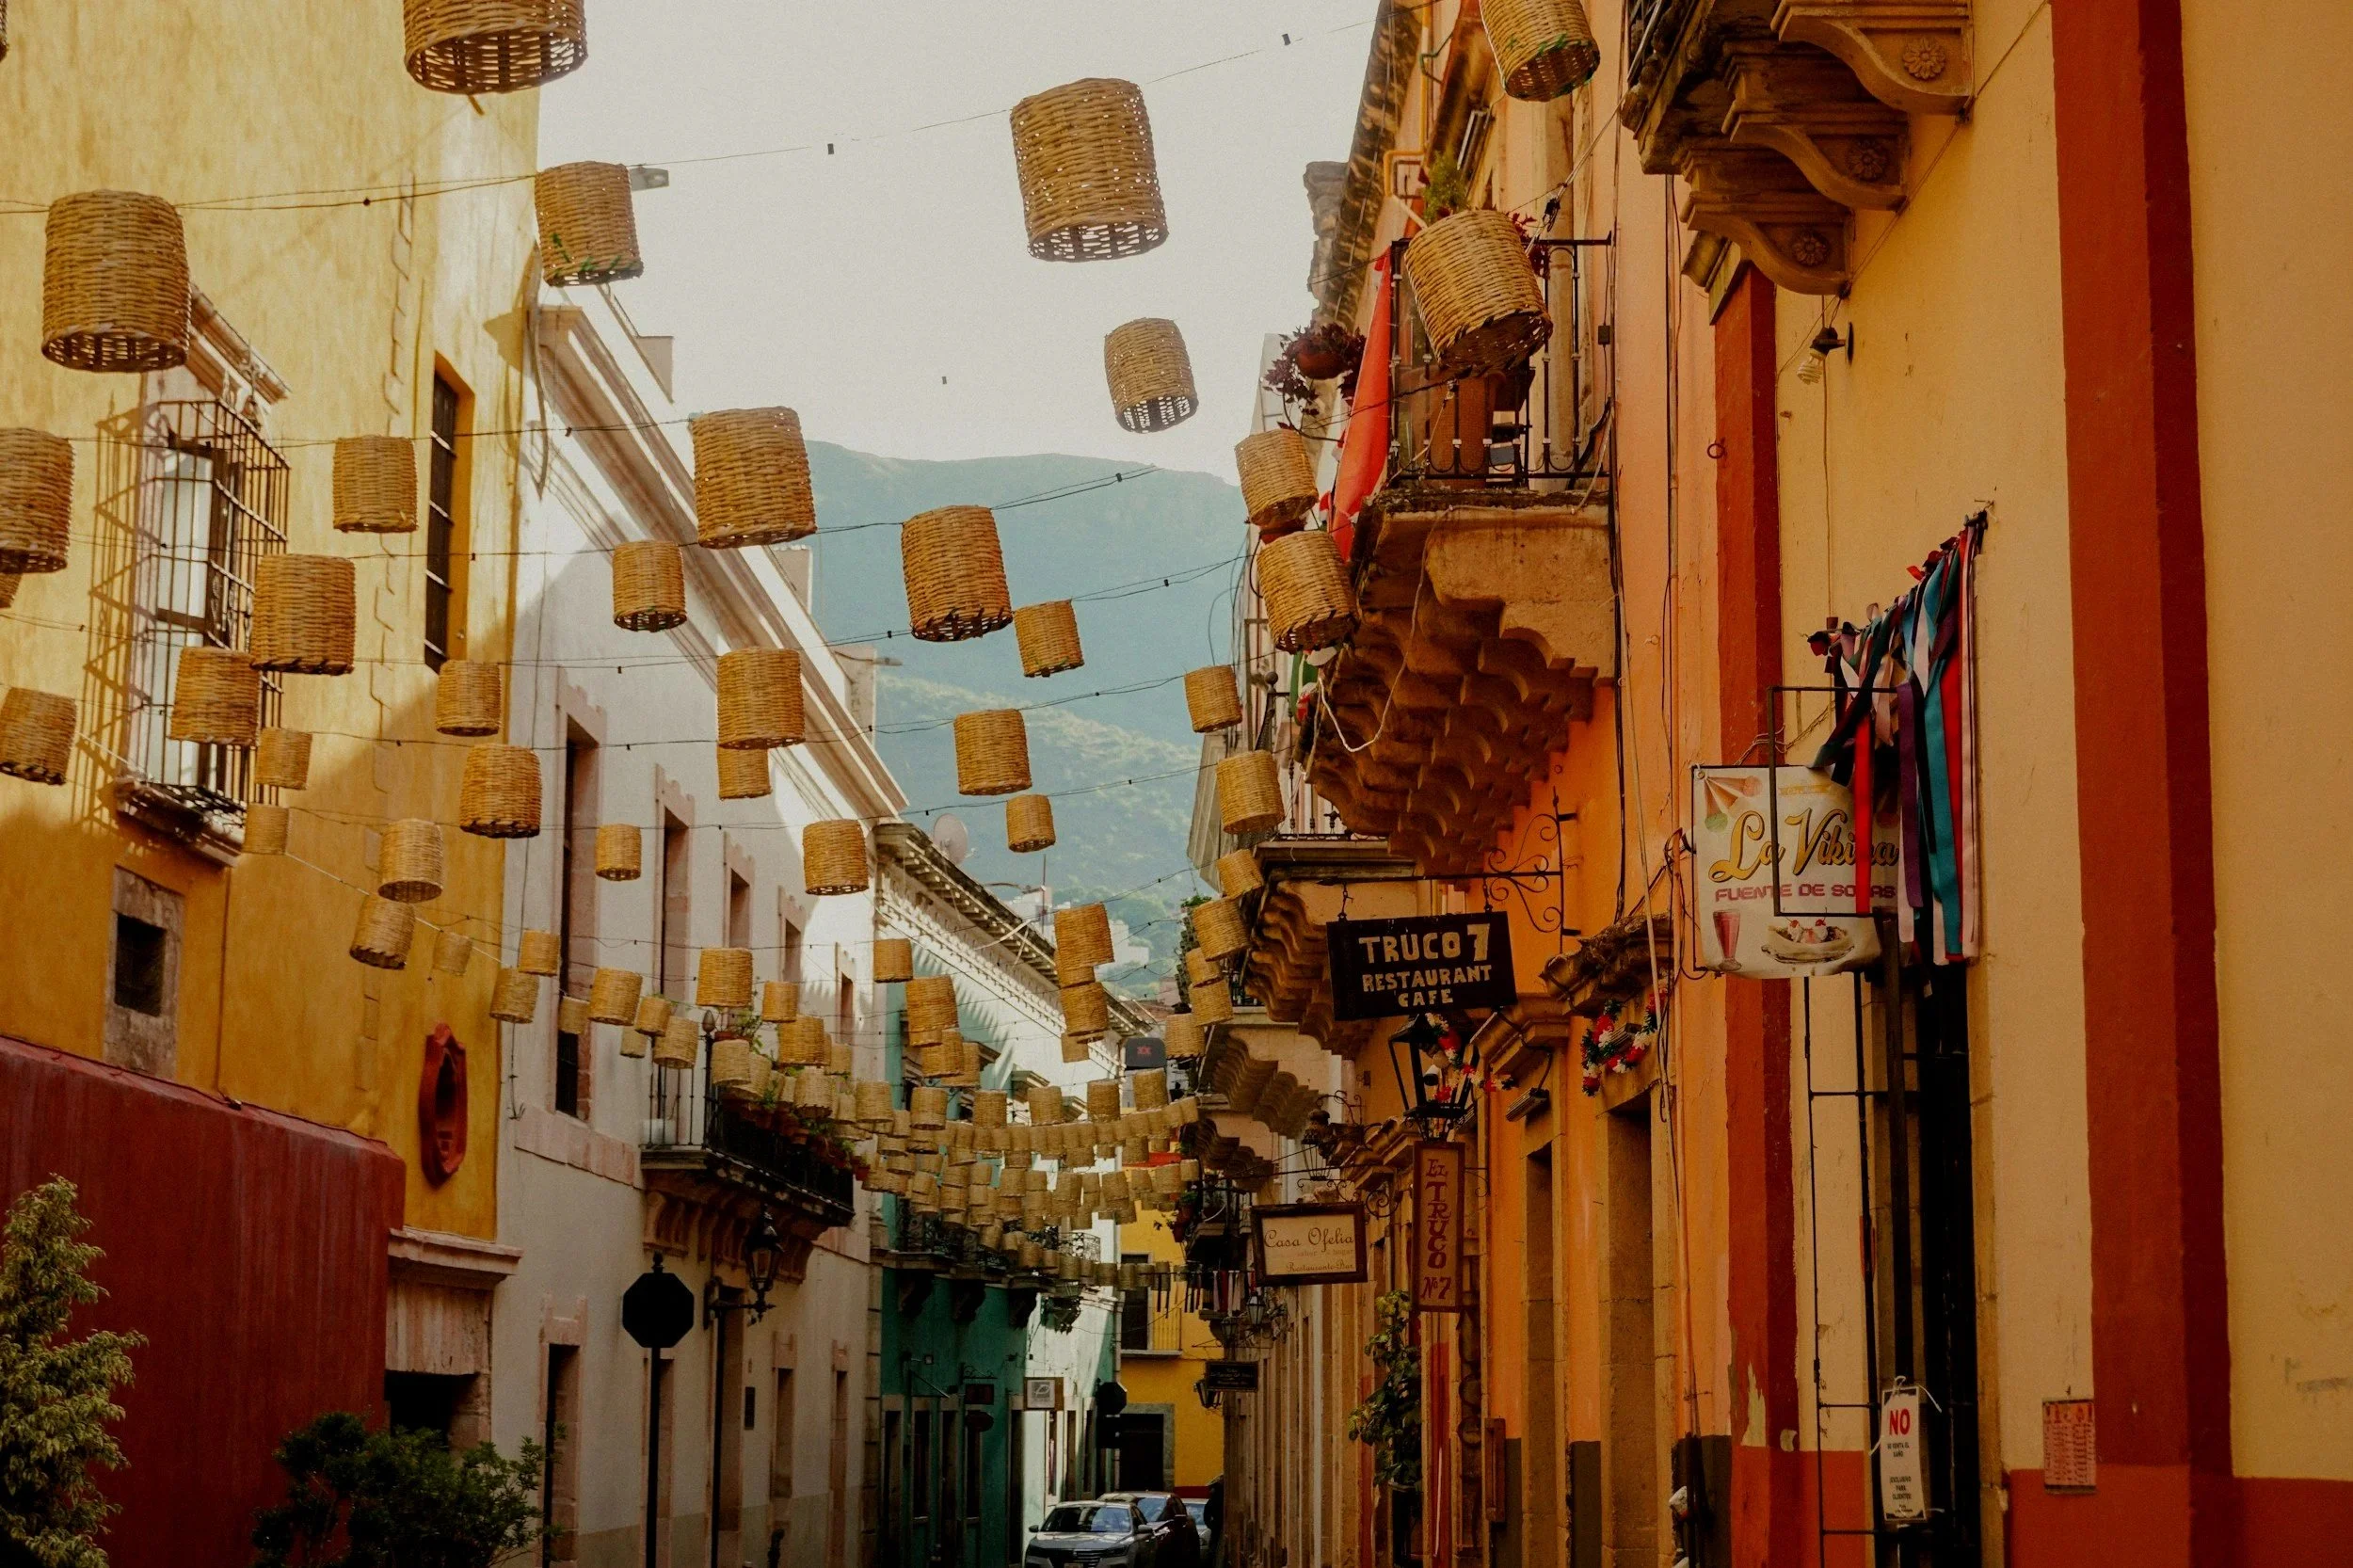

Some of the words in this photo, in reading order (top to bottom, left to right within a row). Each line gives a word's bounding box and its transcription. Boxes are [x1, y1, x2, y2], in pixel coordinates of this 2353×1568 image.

[1708, 809, 1785, 882] La
[1785, 807, 1899, 876] Vikia
[1715, 883, 1793, 903] FUENTE
[1799, 884, 1825, 897] DE
[1832, 884, 1897, 899] SOAS
[1359, 932, 1461, 964] TRUCO
[1466, 923, 1491, 962] 7
[1362, 965, 1493, 992] RESTAURANT
[1398, 989, 1454, 1008] CAFE
[1426, 1159, 1448, 1177] EL
[1425, 1181, 1451, 1269] TRUCO
[1264, 1229, 1302, 1248] Casa
[1307, 1227, 1354, 1253] Ofelia
[1889, 1408, 1911, 1436] NO
